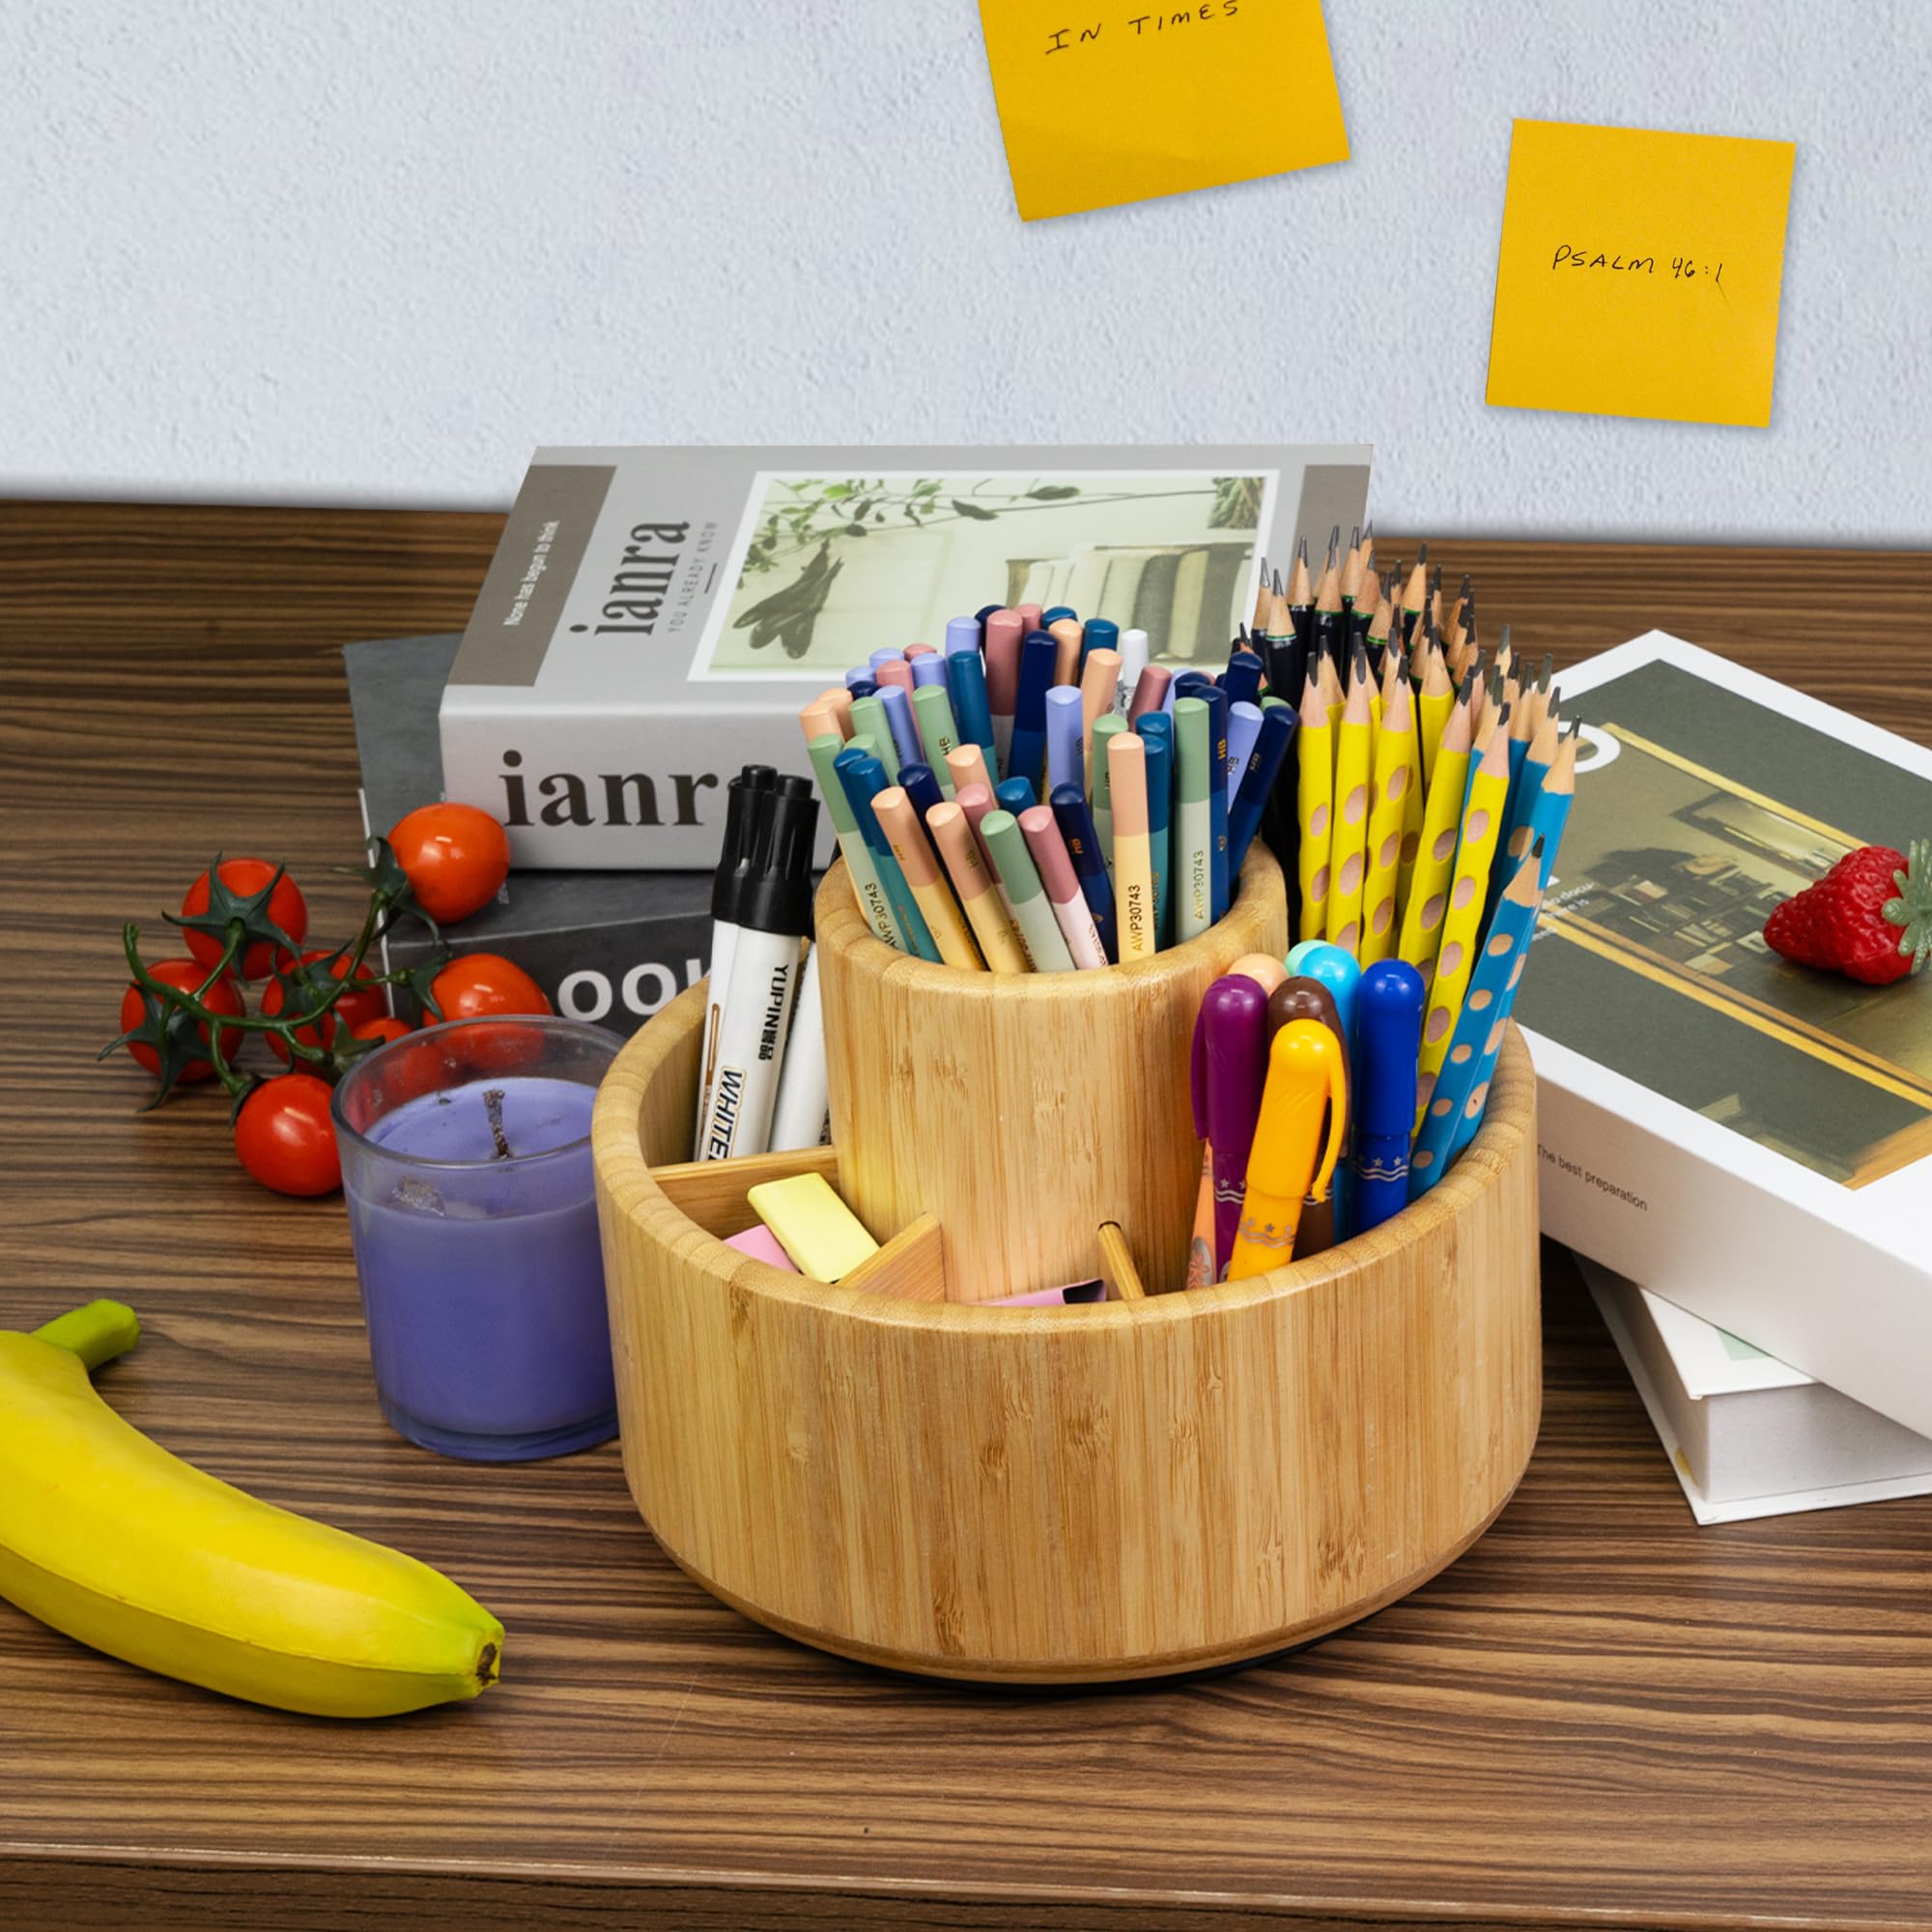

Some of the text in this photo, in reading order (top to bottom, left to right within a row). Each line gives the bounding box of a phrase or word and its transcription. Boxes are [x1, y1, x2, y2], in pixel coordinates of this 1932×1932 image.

[1044, 0, 1238, 55] IN TIMES
[1552, 244, 1723, 283] PSALM 46:1
[569, 521, 691, 637] ianra
[498, 749, 742, 827] ianr
[1127, 884, 1145, 952] AWP30743
[1192, 849, 1206, 921] AWP30743
[557, 958, 701, 1022] OO
[764, 963, 789, 1029] YUPIN
[708, 1065, 743, 1160] WHITE
[1558, 1155, 1582, 1178] best
[1584, 1171, 1648, 1211] preparation
